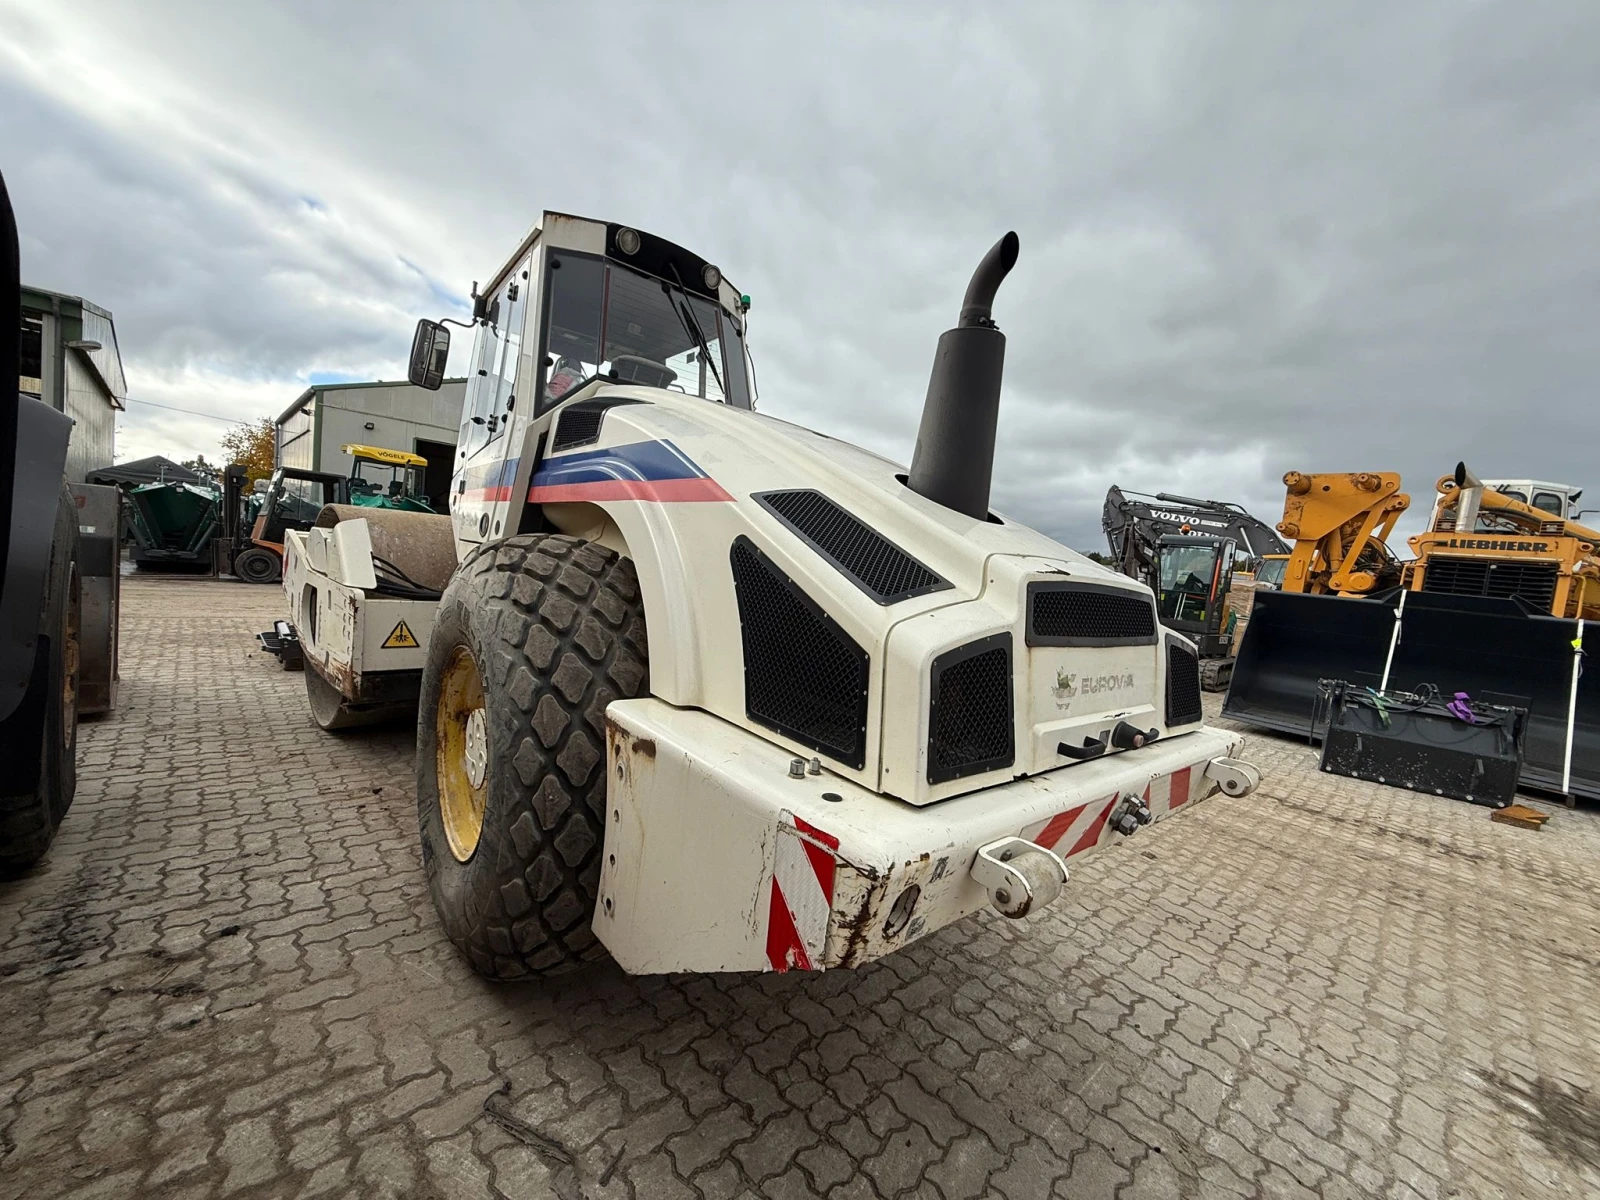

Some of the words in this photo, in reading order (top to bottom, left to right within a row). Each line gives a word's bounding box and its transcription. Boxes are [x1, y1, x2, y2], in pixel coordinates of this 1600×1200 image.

[377, 451, 405, 460] VÖGELE
[1150, 509, 1200, 525] VOLVO
[1449, 538, 1549, 553] LIEBHERR
